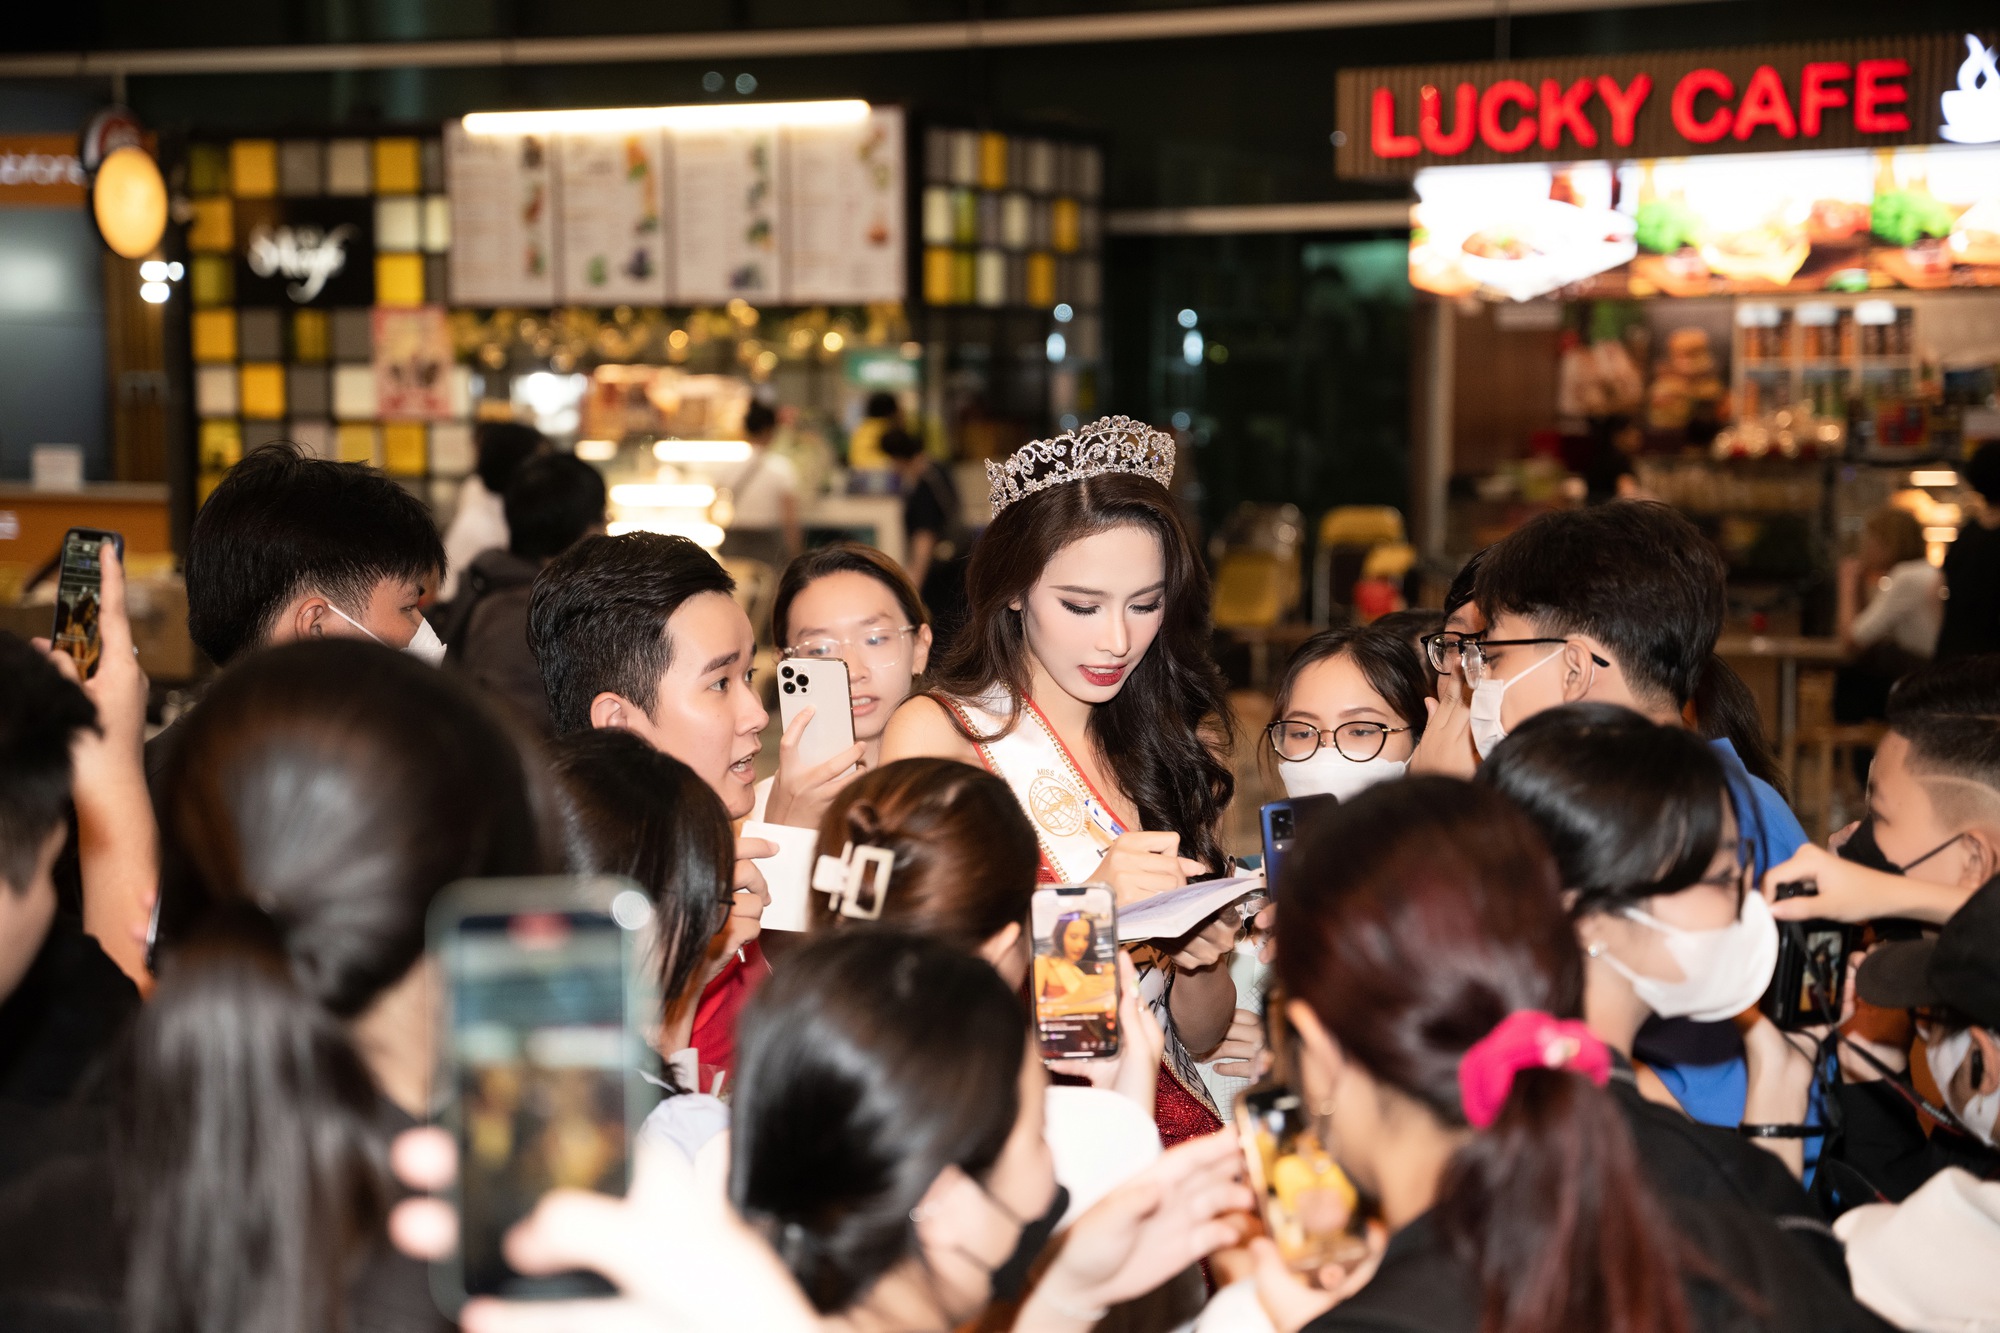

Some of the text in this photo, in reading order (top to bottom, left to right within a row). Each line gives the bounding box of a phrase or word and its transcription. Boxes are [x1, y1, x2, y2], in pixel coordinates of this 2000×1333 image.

[1371, 58, 1911, 159] LUCKY CAFE
[1036, 768, 1055, 777] MISS
